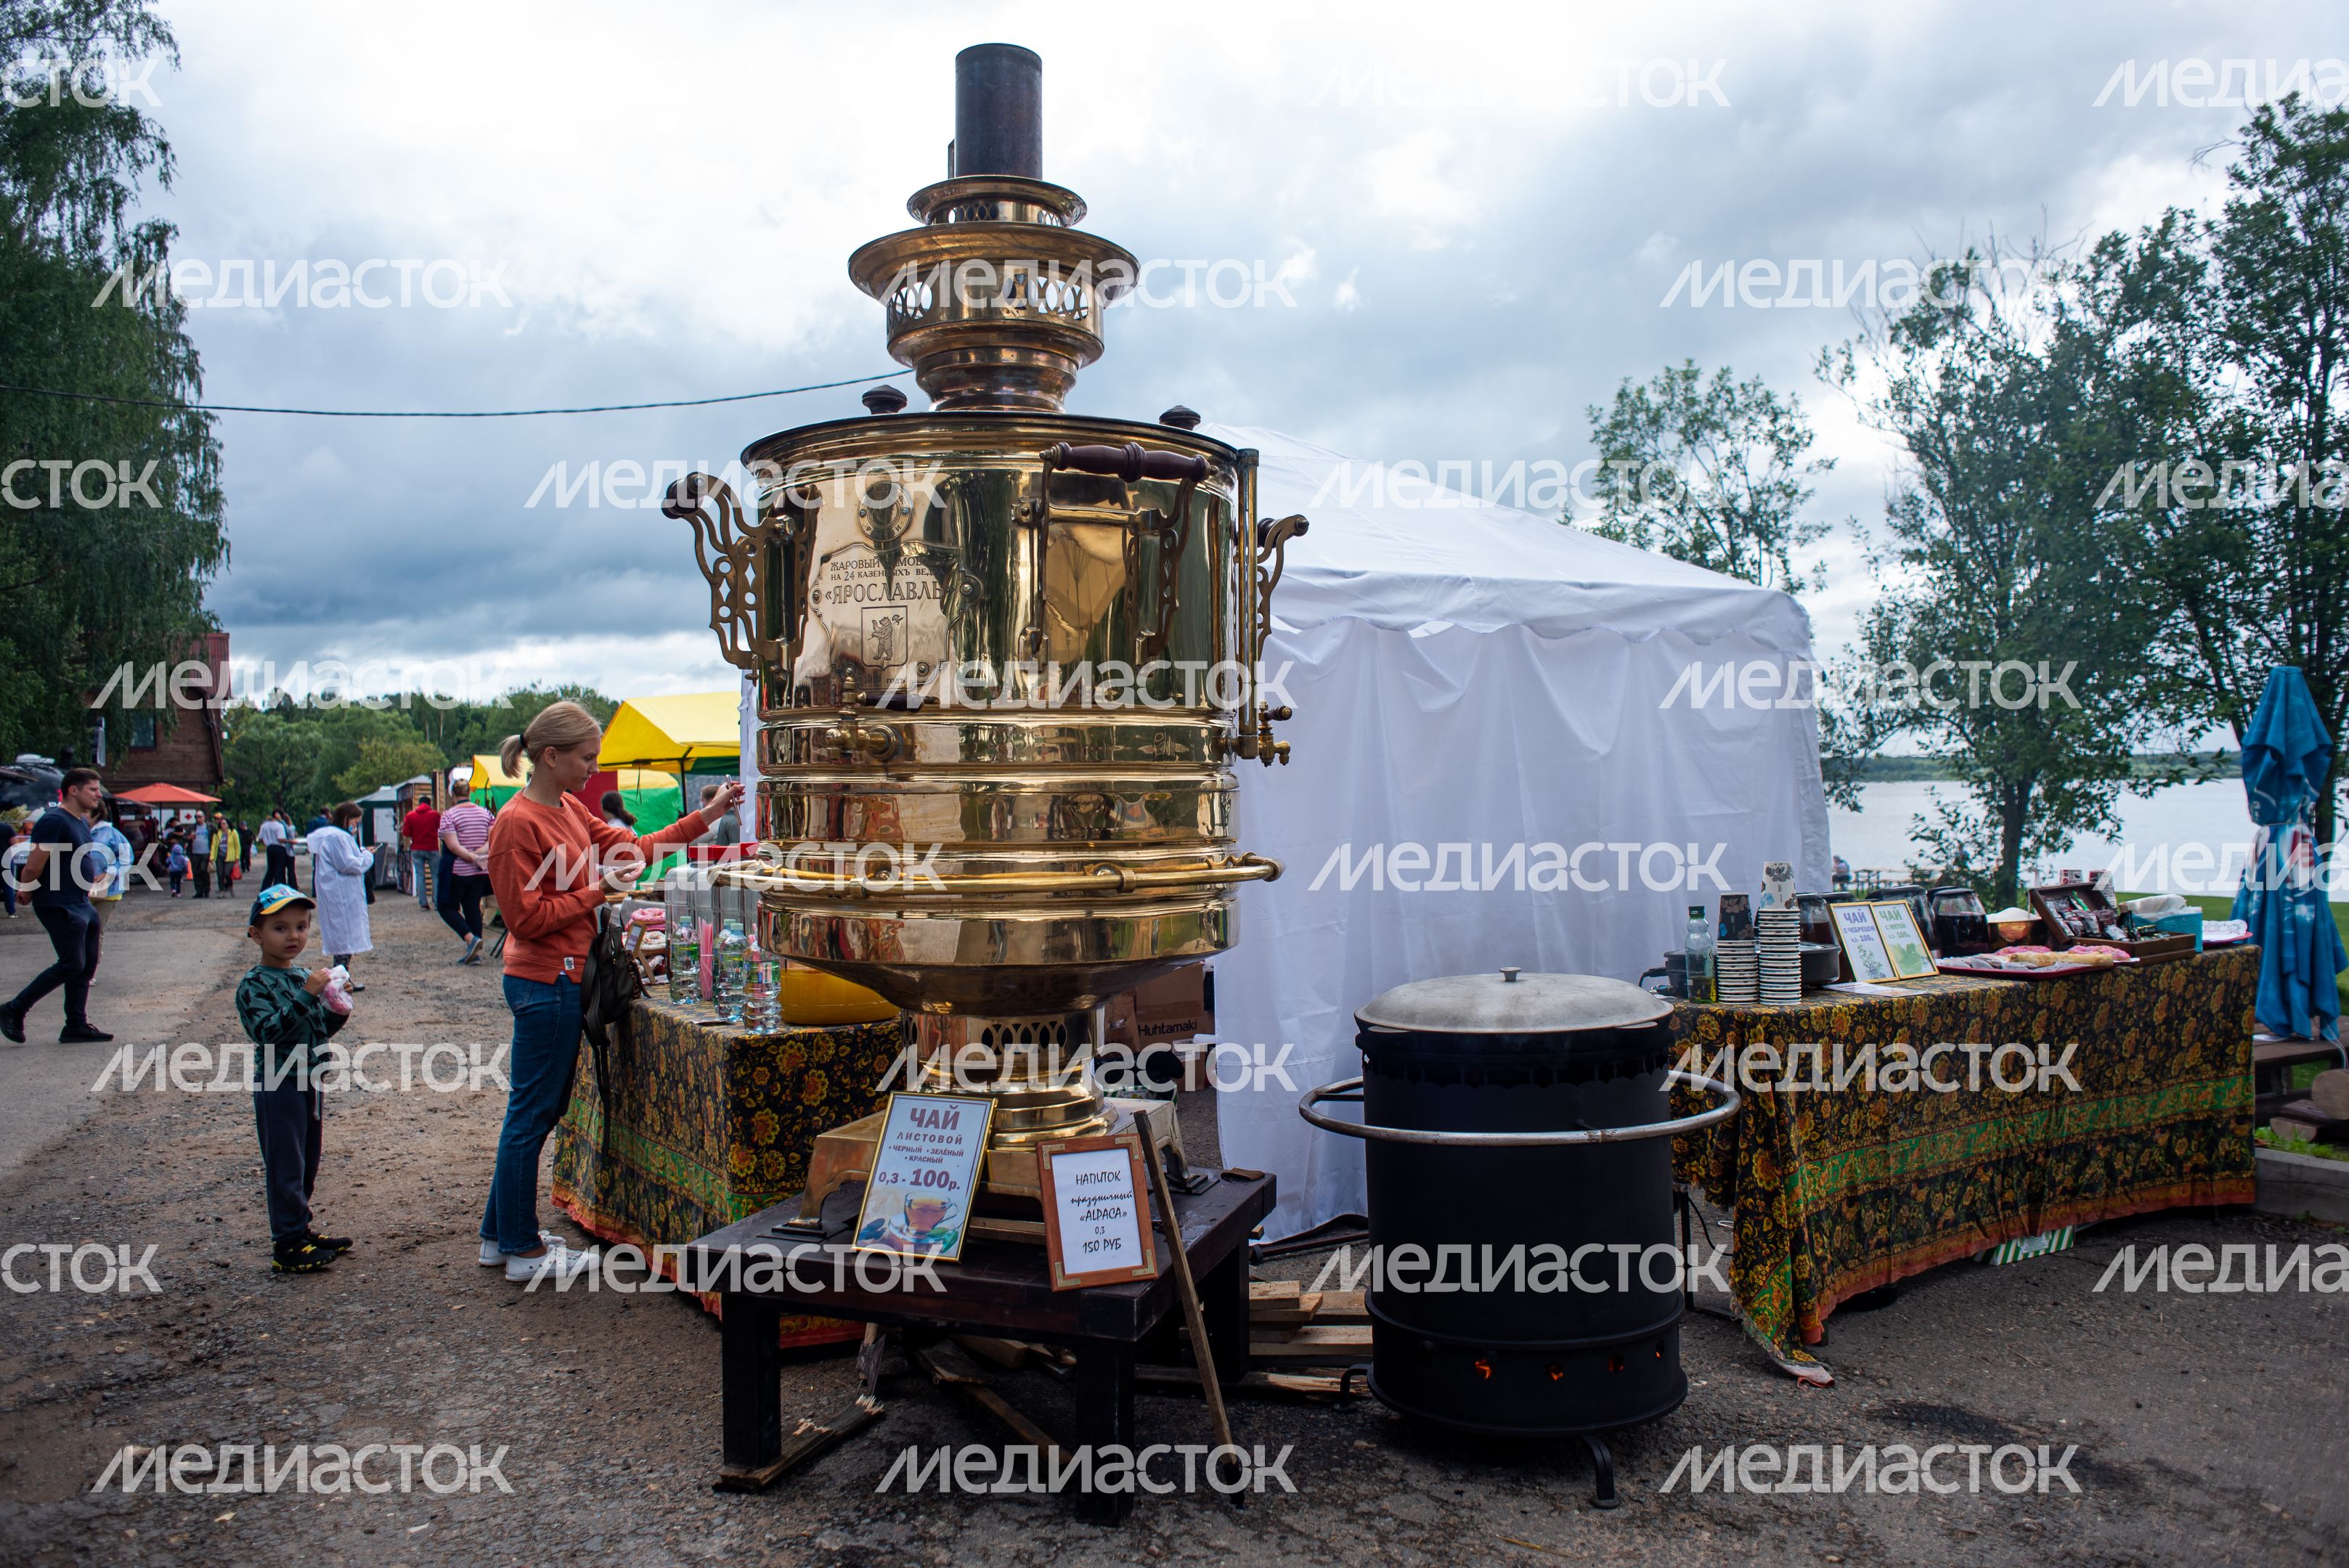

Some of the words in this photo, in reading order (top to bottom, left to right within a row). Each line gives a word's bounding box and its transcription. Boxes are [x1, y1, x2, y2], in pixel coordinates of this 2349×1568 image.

[830, 555, 880, 572] ЖАРОВЫЙ
[844, 571, 855, 581] 24
[825, 580, 955, 605] «ЯРОСЛАВЛЬ»
[1843, 908, 1867, 924] ЧАЙ
[1878, 906, 1902, 922] ЧАЙ
[1137, 1018, 1197, 1037] Huhtamaki
[910, 1104, 961, 1131] ЧАЙ
[896, 1132, 964, 1146] ЛИСТОВОЙ
[893, 1145, 923, 1153] ЧЕРНЫЙ
[909, 1155, 943, 1164] КРАСНЫЙ
[879, 1171, 900, 1185] 0,3
[909, 1168, 961, 1191] 100р.
[1075, 1170, 1121, 1185] НАПИТОК
[1070, 1189, 1133, 1207] праздничный
[1080, 1206, 1128, 1222] «ALPACA»
[1094, 1226, 1105, 1235] 0,3
[1082, 1239, 1100, 1254] 150
[1103, 1237, 1122, 1251] РУБ
